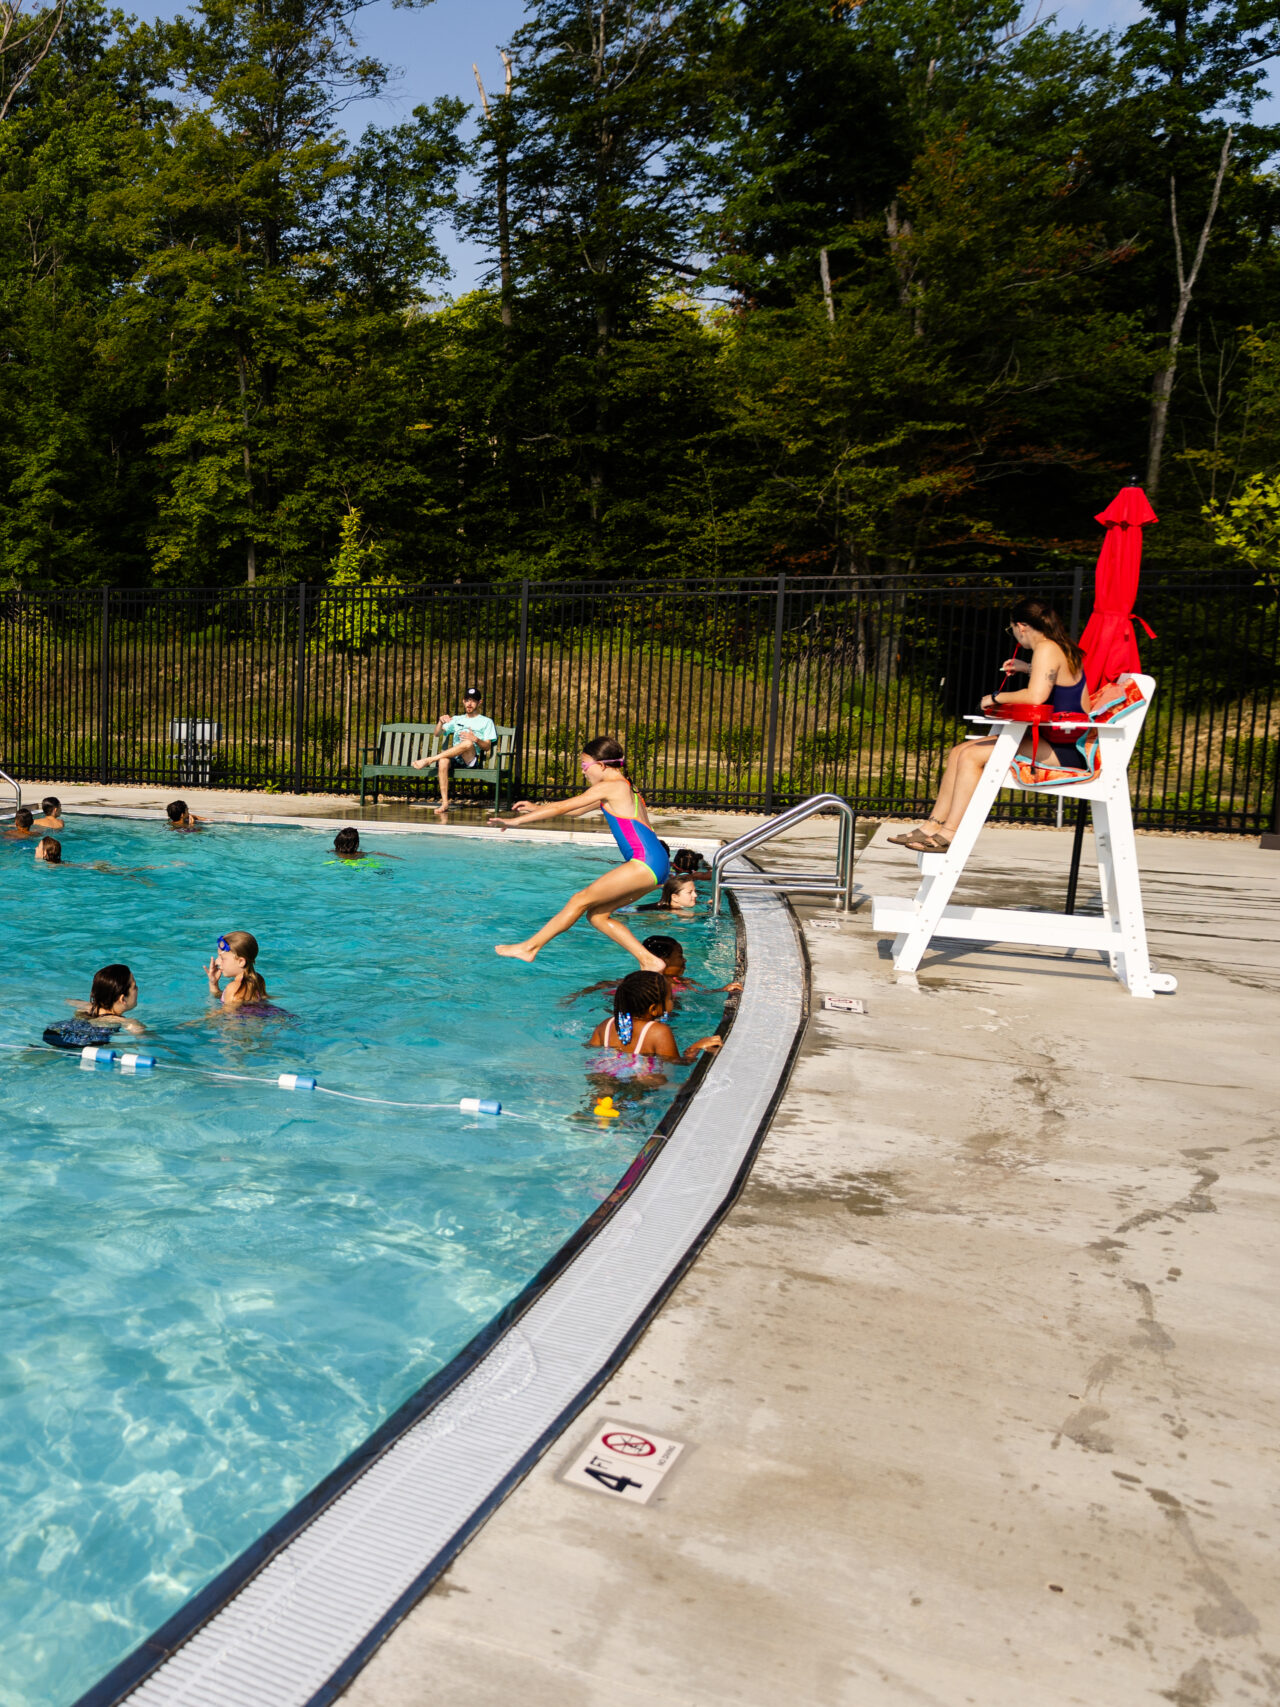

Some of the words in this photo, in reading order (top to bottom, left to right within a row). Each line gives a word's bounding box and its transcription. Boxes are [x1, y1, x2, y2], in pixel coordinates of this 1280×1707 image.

[663, 1445, 677, 1460] DIVING
[590, 1455, 613, 1470] FT
[584, 1467, 643, 1493] 4
